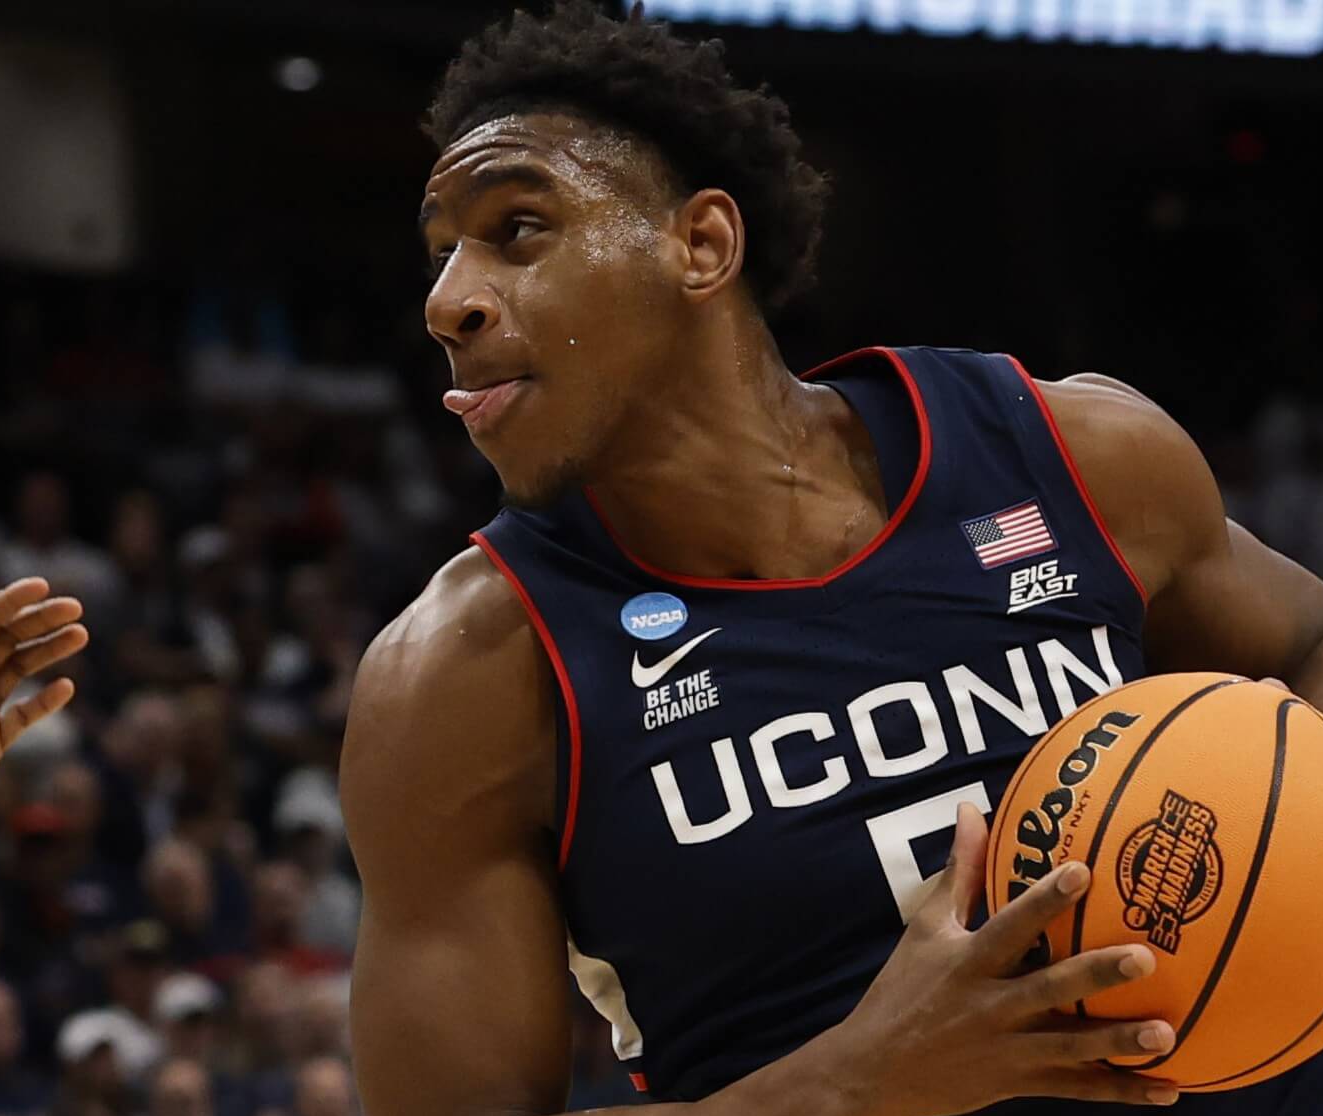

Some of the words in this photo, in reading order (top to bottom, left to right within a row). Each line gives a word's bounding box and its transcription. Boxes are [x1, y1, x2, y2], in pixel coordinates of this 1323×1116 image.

[1010, 560, 1058, 589] BIG
[1010, 574, 1078, 605] EAST
[630, 609, 684, 630] NCAA
[644, 687, 720, 730] CHANGE
[646, 685, 671, 710] BE
[676, 669, 711, 698] THE
[650, 625, 1124, 845] UCONN
[1070, 790, 1091, 828] NXT
[1133, 828, 1176, 909] MARCH
[1157, 804, 1212, 909] MADNESS
